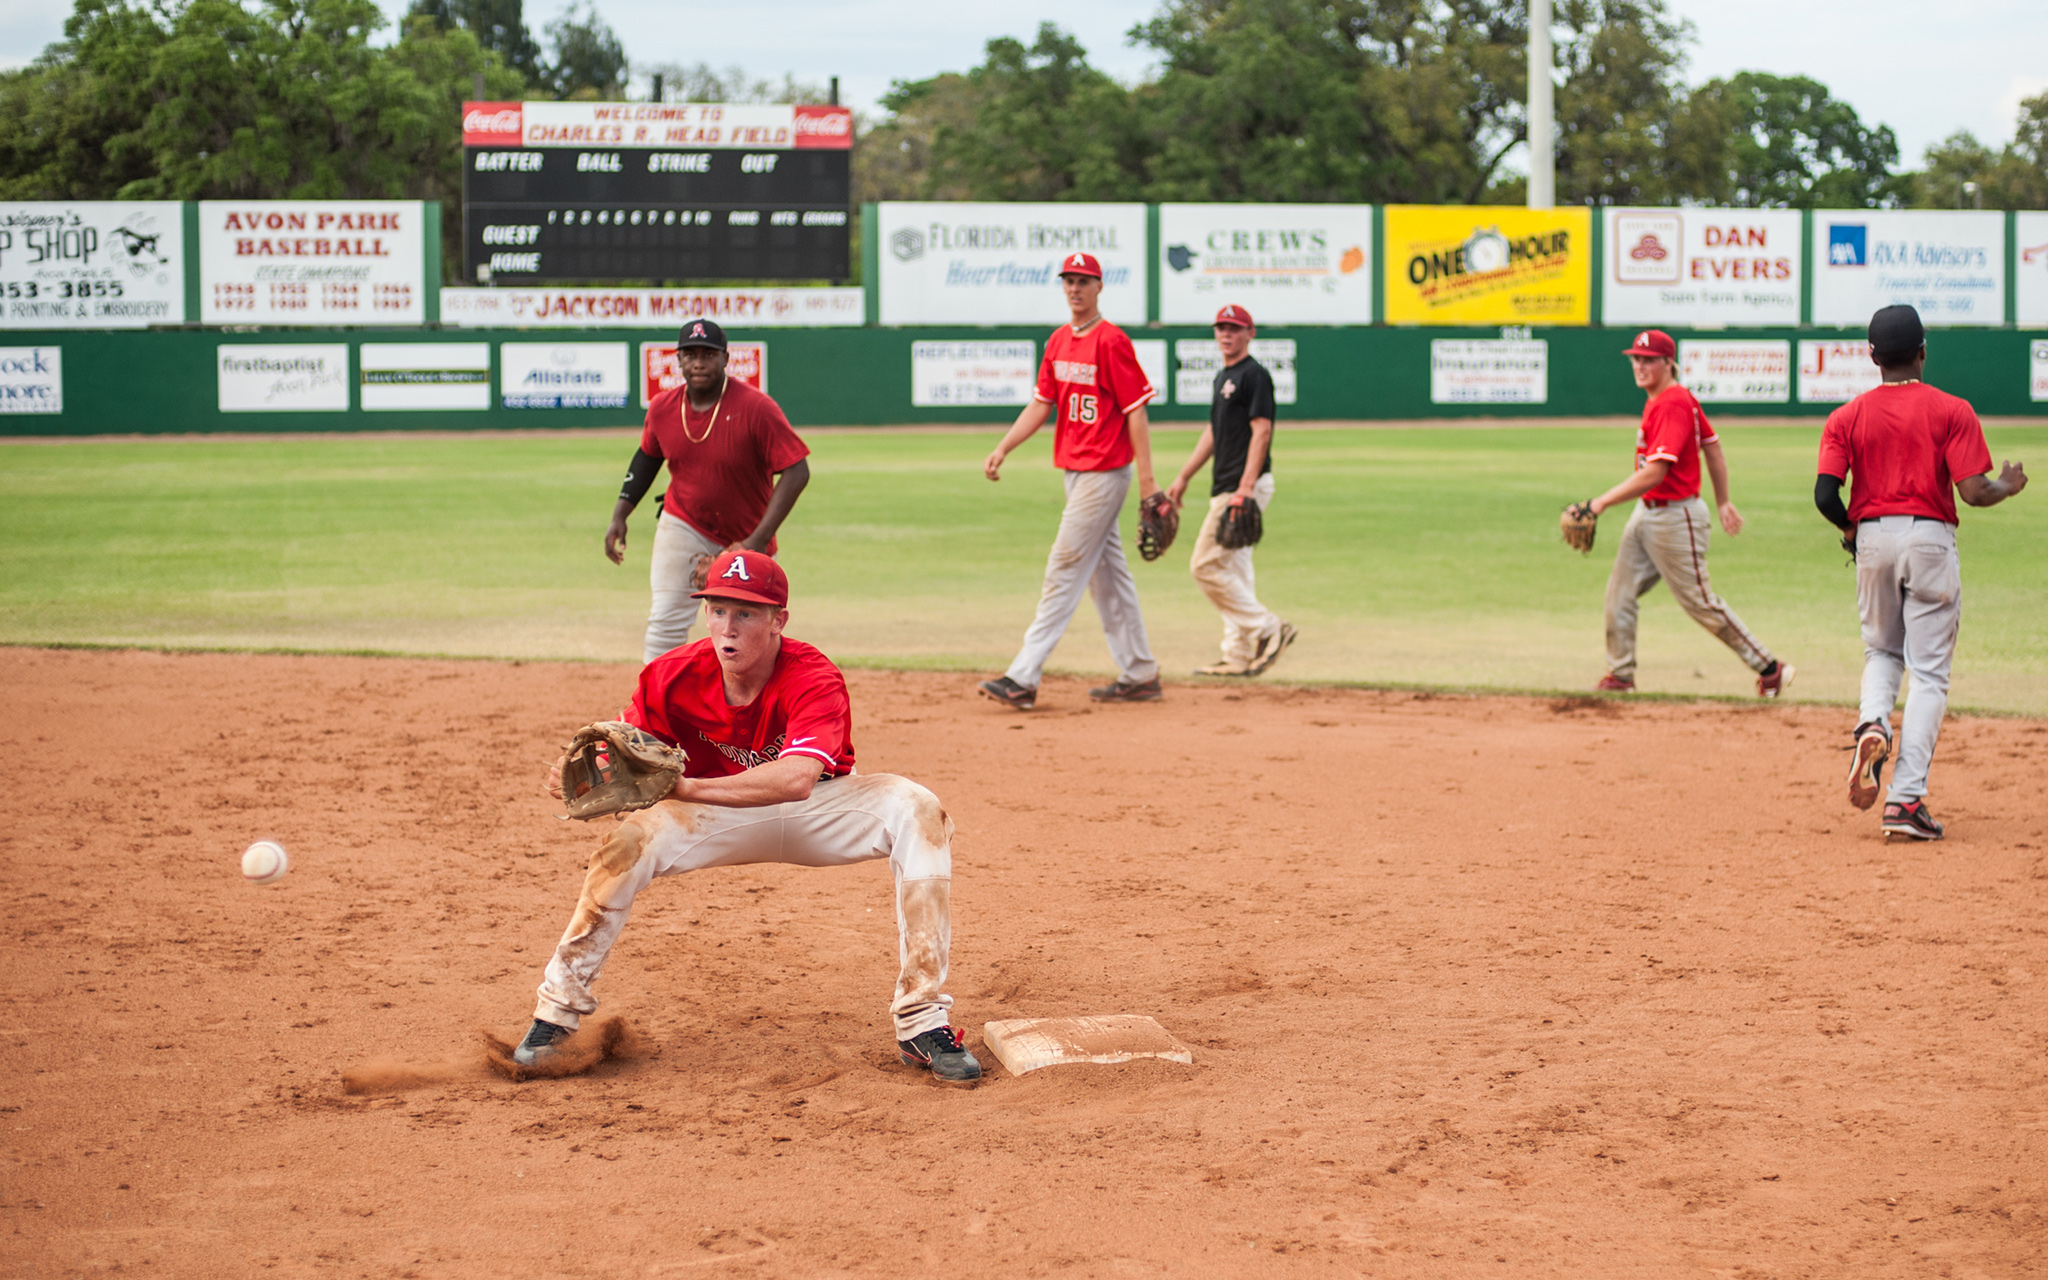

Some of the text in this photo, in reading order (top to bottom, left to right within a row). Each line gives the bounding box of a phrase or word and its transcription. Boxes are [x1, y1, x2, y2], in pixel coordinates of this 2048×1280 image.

[594, 106, 723, 121] WELCOME TO
[528, 125, 623, 142] CHARLES
[665, 127, 722, 143] HEAD
[731, 127, 789, 144] FIELD
[475, 152, 779, 174] BATTER BALL STRIKE OUT
[224, 211, 400, 231] AVON PARK
[548, 210, 557, 225] 1
[482, 225, 541, 245] GUEST
[928, 222, 1120, 250] FLORIDA HOSPITAL
[1206, 229, 1328, 253] CREWS
[1704, 225, 1767, 248] DAN
[25, 227, 97, 264] SHOP
[235, 237, 390, 257] BASEBALL
[490, 252, 542, 272] HOME
[1070, 252, 1085, 267] A
[1409, 230, 1570, 285] ONE HOUR
[945, 259, 1051, 286] Heartland
[1690, 258, 1791, 281] EVERS
[10, 301, 71, 318] PRINTING
[75, 302, 88, 317] &
[94, 301, 170, 318] EMBROIDERY
[536, 295, 764, 318] JACKSON MASONARY
[1222, 305, 1236, 318] A
[689, 322, 708, 339] A
[1637, 331, 1650, 348] A
[222, 356, 325, 376] firstbaptist
[523, 369, 603, 385] Allstate
[1068, 392, 1099, 424] 15
[721, 555, 750, 581] A
